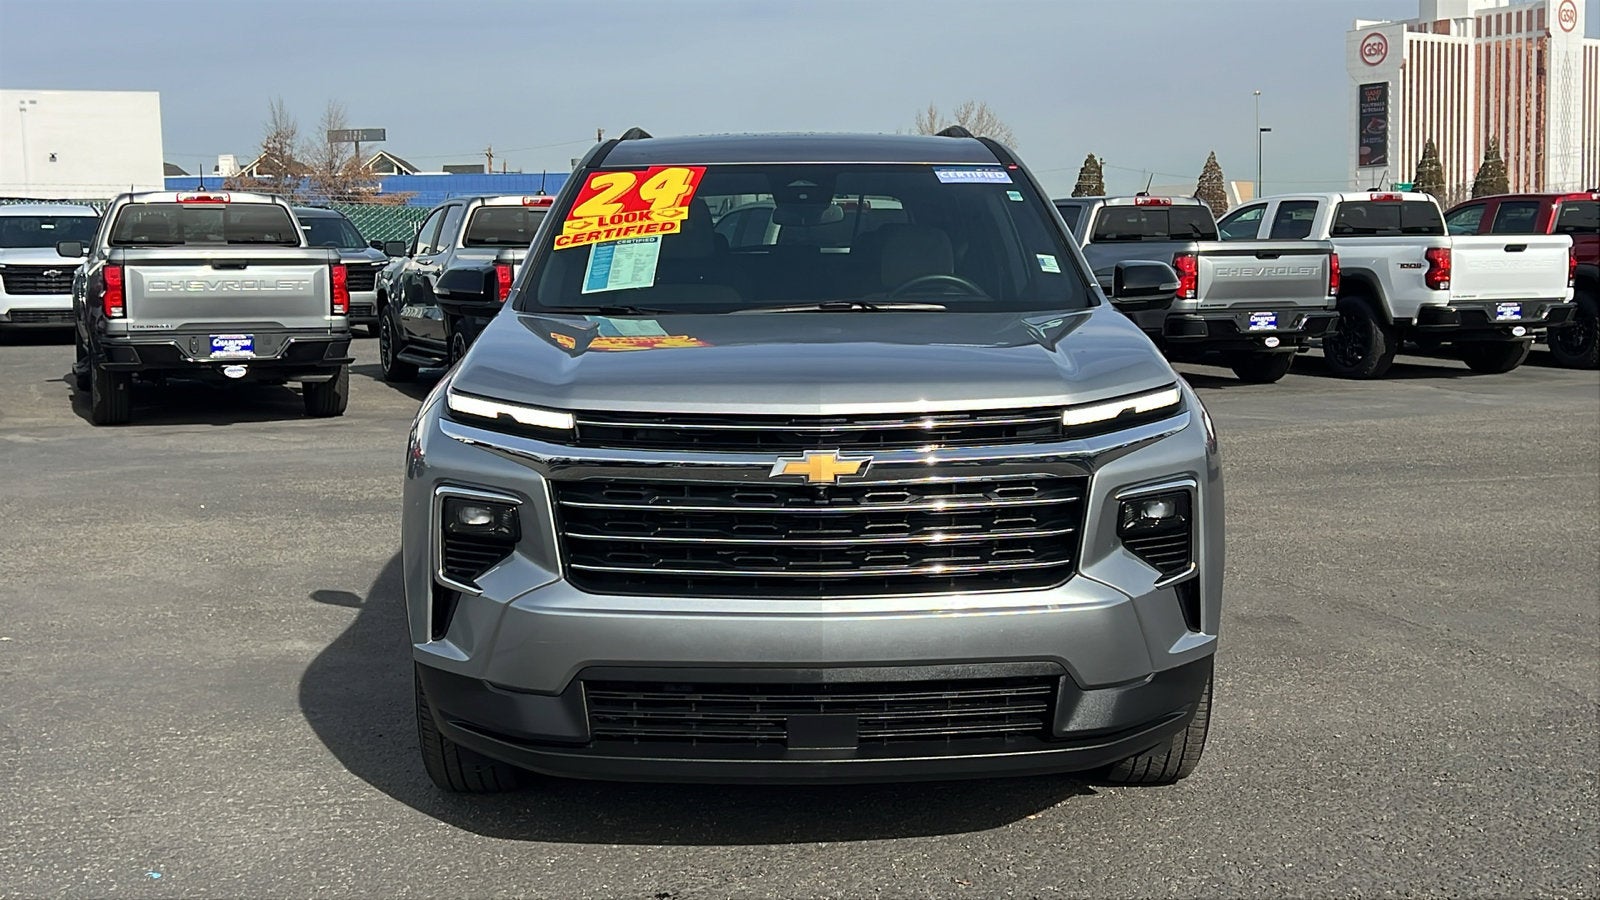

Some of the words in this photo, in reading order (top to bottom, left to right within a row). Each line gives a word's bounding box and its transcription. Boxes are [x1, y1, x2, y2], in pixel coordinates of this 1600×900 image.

[1560, 8, 1576, 23] GSR
[1363, 43, 1384, 57] GSR
[573, 168, 694, 217] 24
[598, 210, 654, 227] LOOK
[556, 221, 676, 246] CERTIFIED
[616, 237, 656, 245] CERTIFIED
[1216, 265, 1319, 277] CHEVROLET
[148, 280, 309, 292] CHEVROLET
